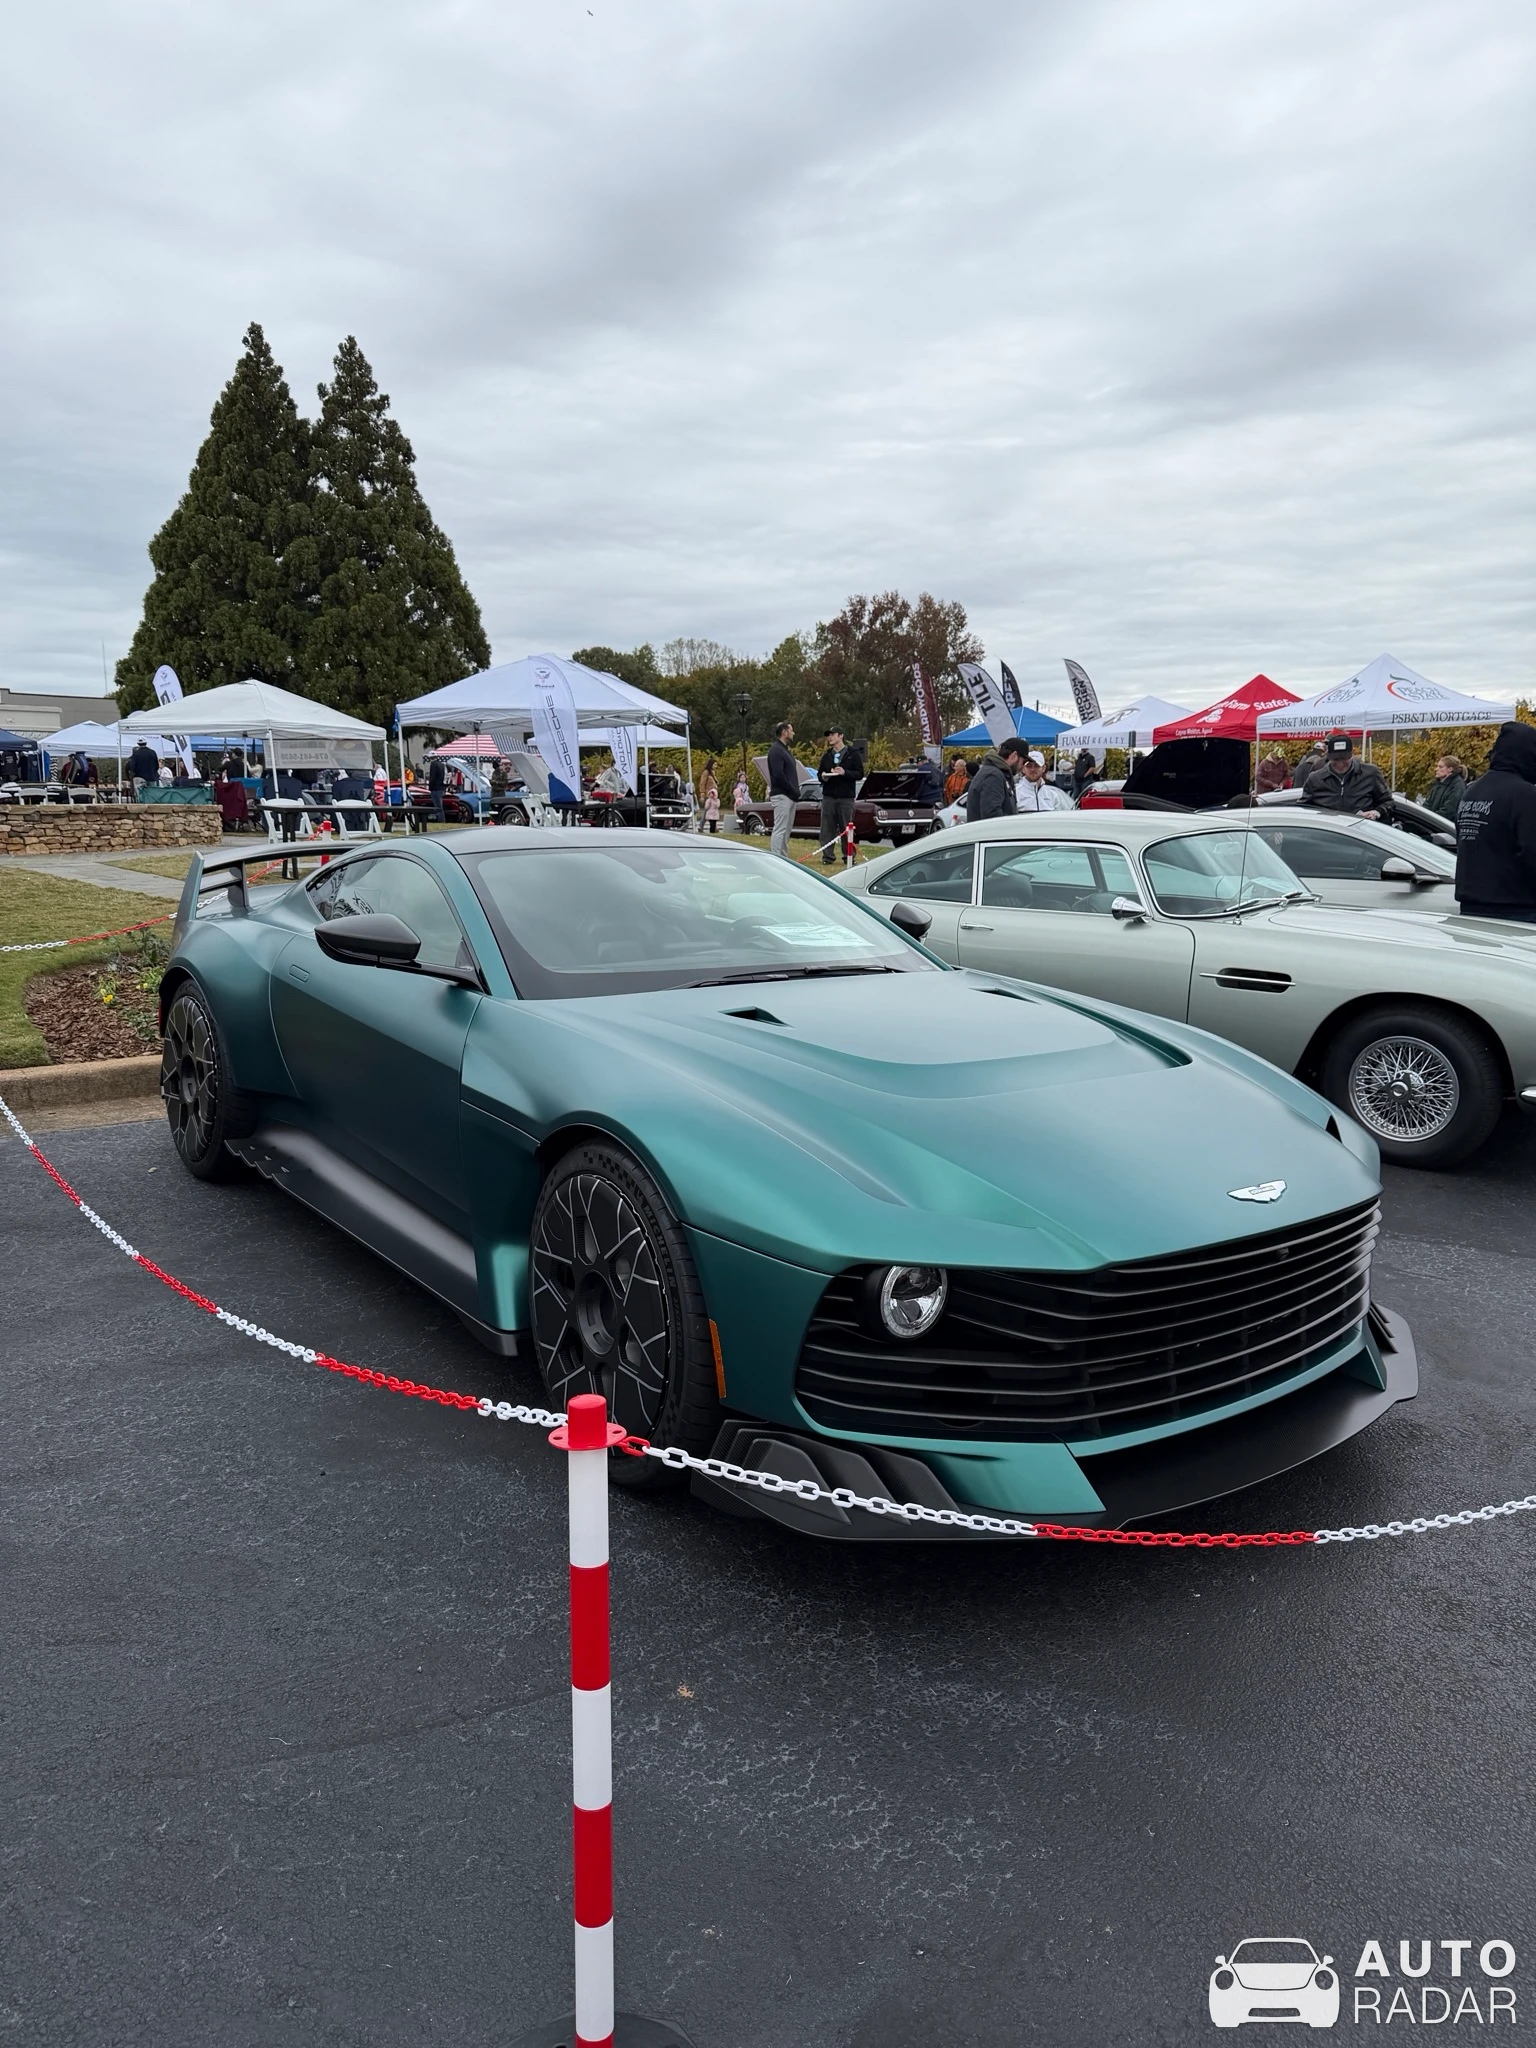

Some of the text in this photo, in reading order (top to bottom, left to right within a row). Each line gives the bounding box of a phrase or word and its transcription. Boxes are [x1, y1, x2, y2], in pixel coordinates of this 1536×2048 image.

[912, 662, 931, 742] HARDWOODS
[968, 673, 996, 717] TILE
[1003, 671, 1017, 710] RPET
[1072, 677, 1088, 724] HROOM
[1078, 680, 1095, 722] ITCHEN
[1273, 715, 1346, 728] PSB&T MORTGAGE
[1391, 711, 1492, 724] PSB&T MORTGAGE
[1062, 736, 1125, 747] FUNARI REALTY
[643, 1205, 677, 1288] MICHELIN
